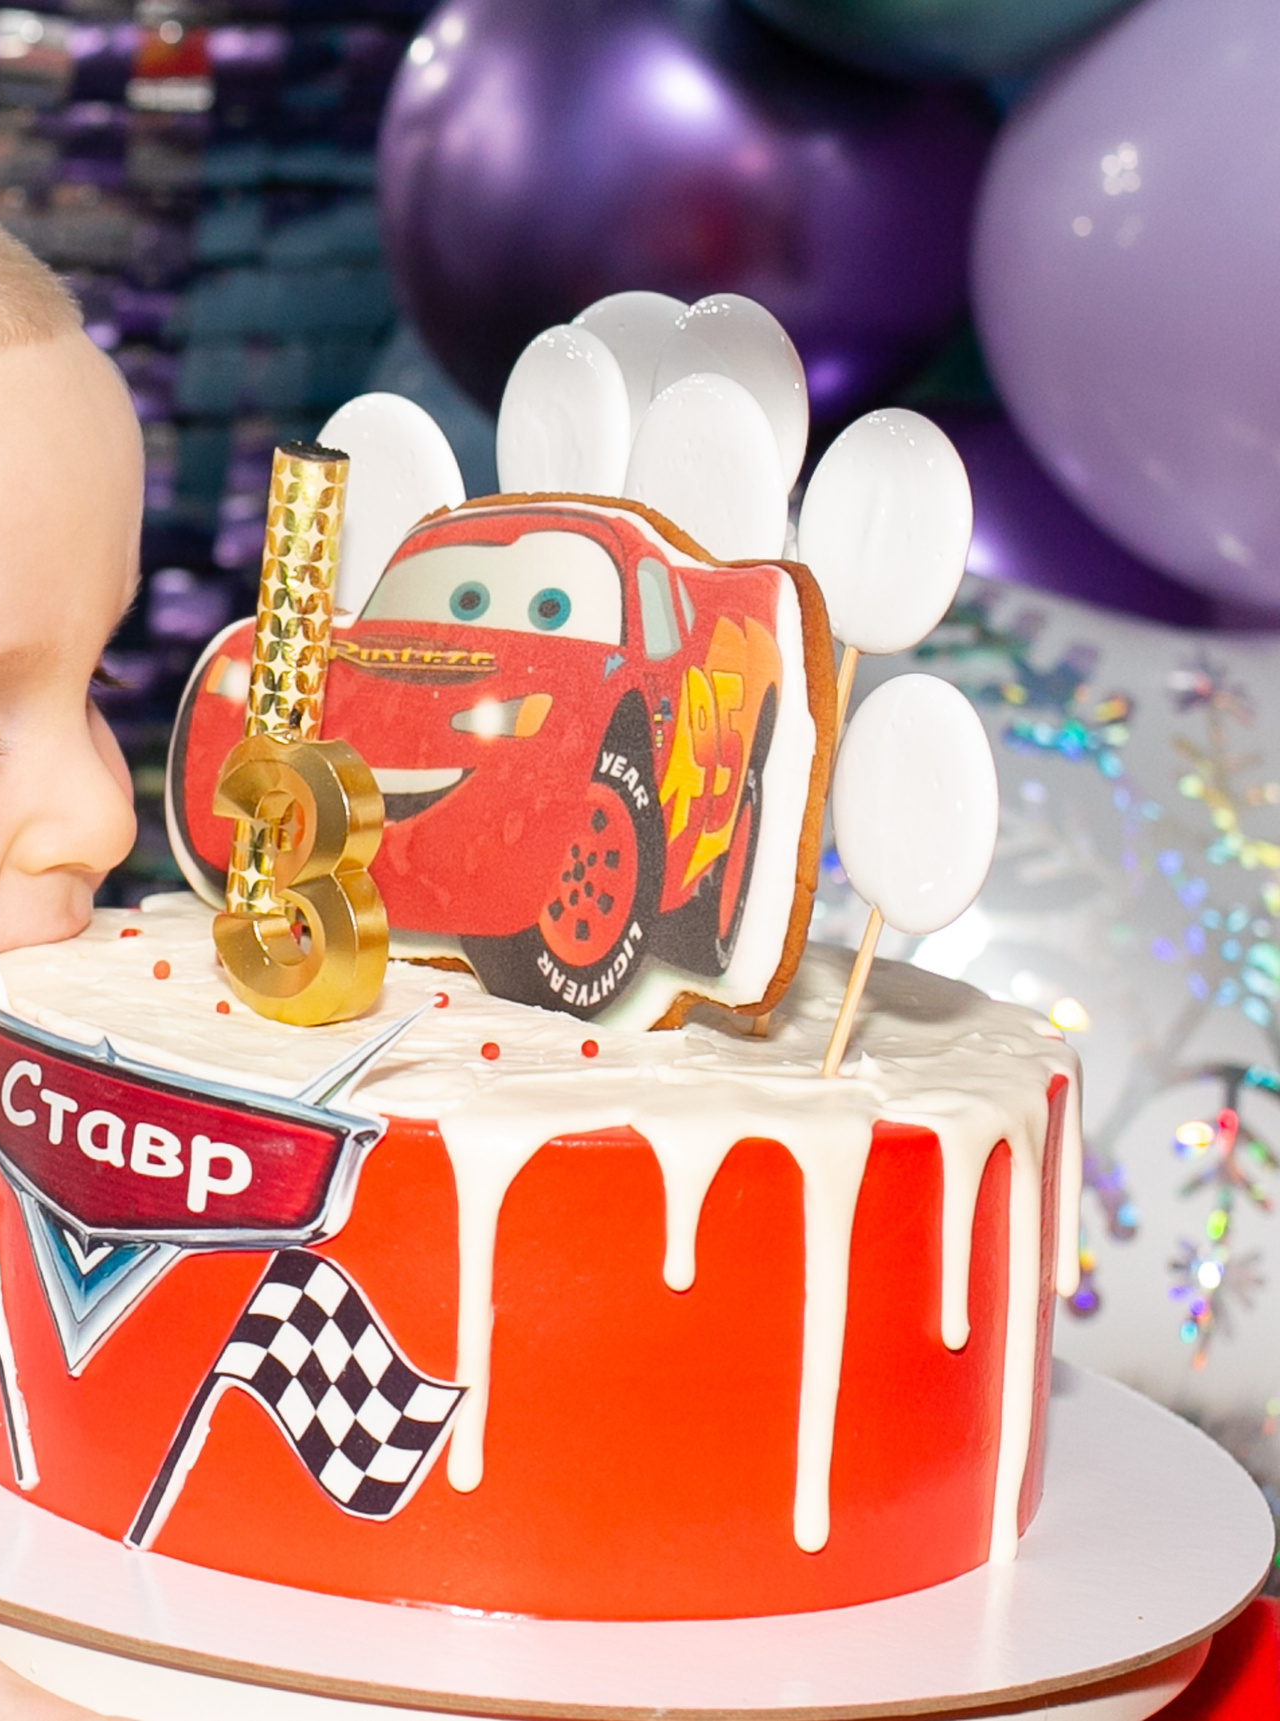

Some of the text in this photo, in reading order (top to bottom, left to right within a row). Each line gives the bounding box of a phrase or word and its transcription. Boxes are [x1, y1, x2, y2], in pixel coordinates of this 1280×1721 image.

[599, 751, 650, 810] YEAR
[687, 664, 744, 833] 95
[212, 732, 389, 1027] 3
[537, 921, 643, 1007] LIGHTYEAR
[0, 1060, 253, 1213] Ставр
